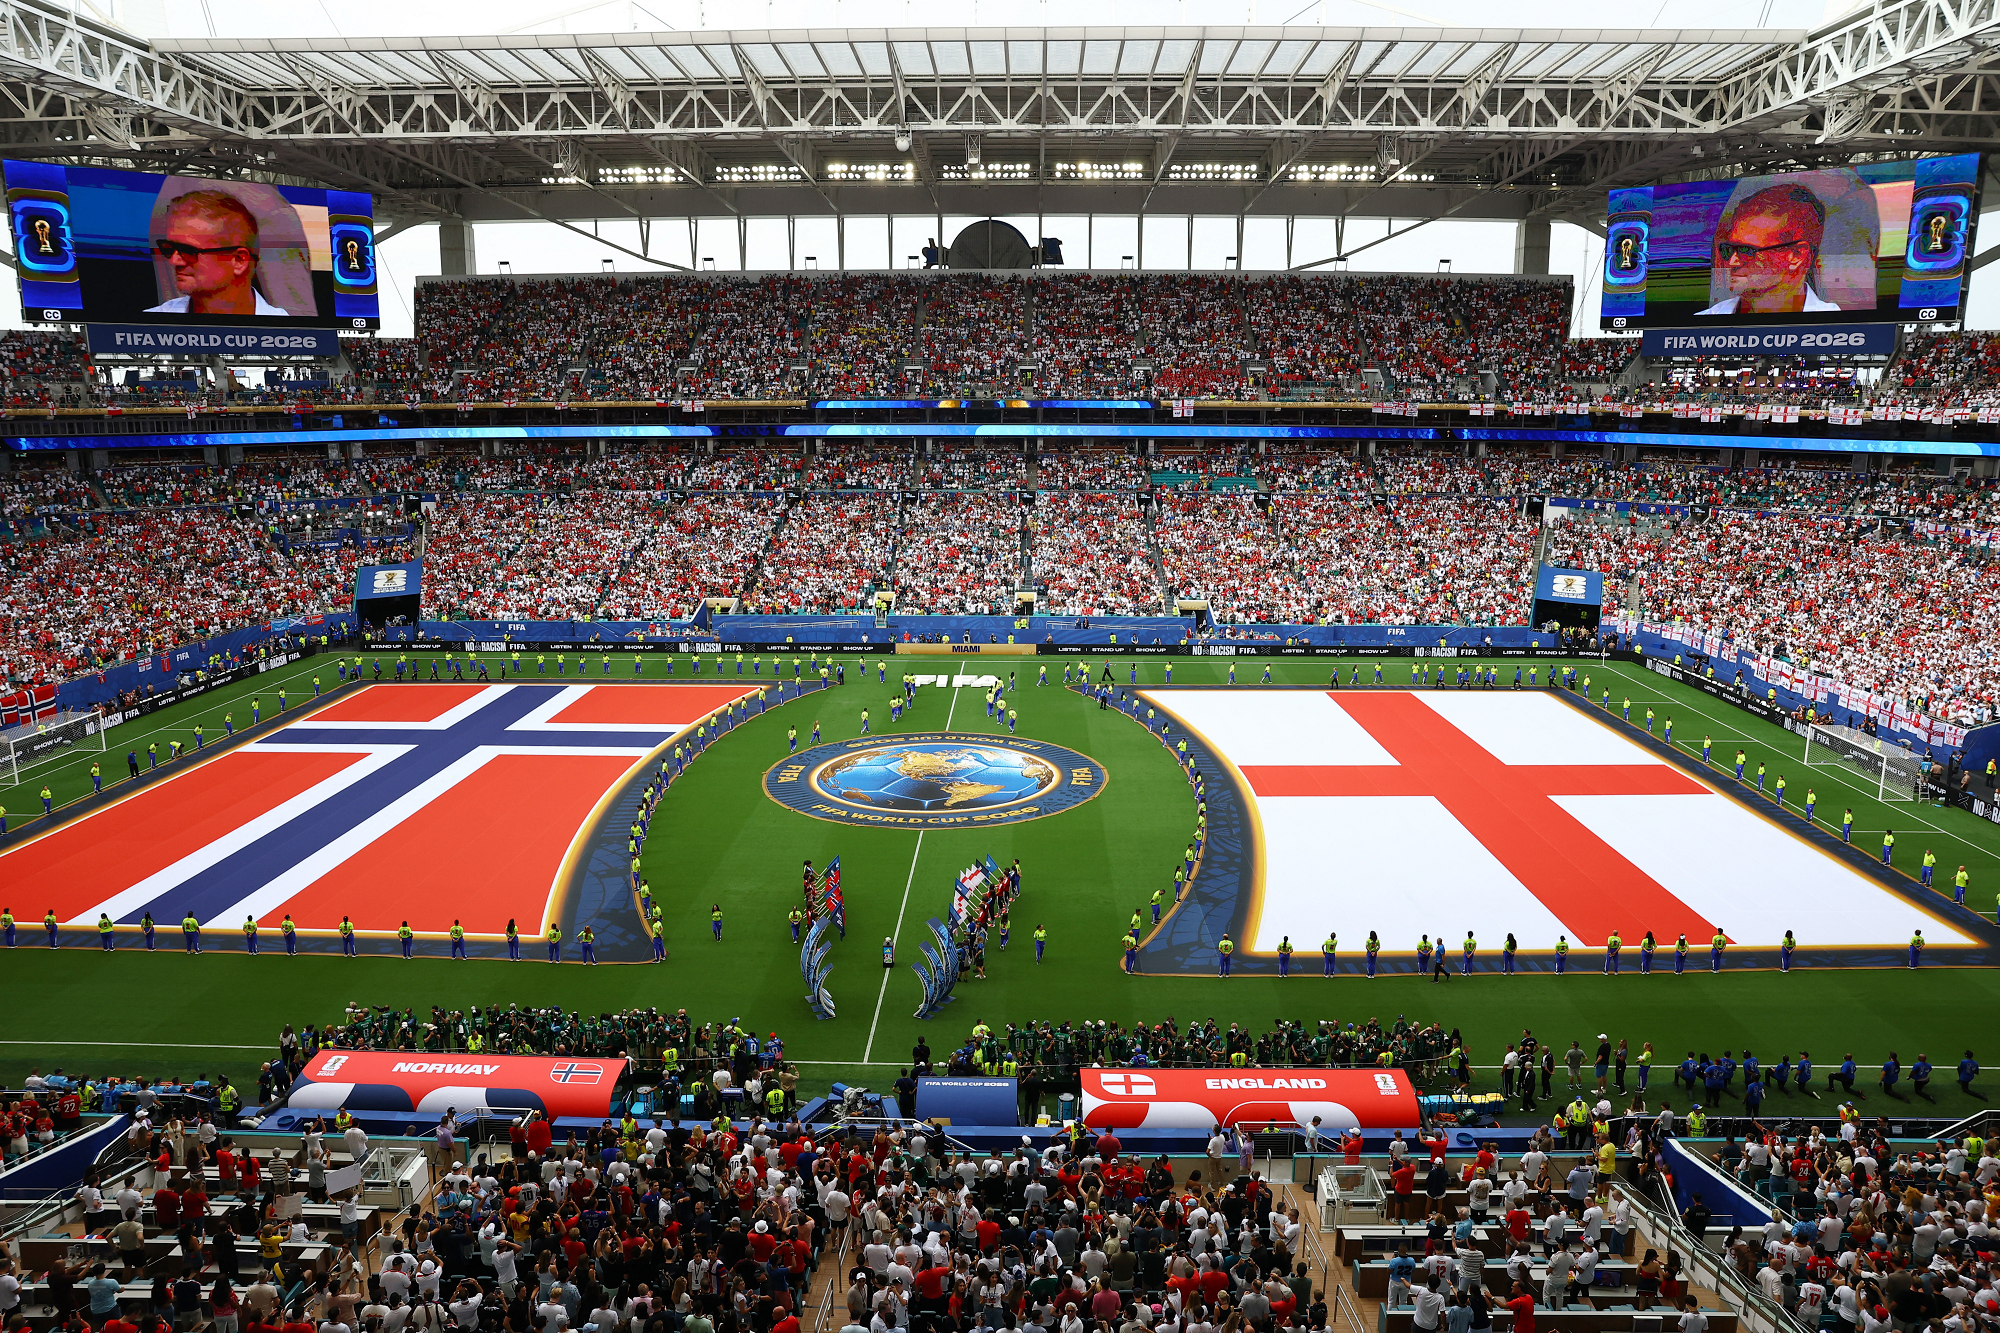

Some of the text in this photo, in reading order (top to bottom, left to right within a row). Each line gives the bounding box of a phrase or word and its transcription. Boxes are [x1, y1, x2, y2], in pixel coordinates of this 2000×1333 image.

[47, 311, 59, 319] CC
[1920, 310, 1936, 319] CC
[354, 319, 365, 327] CC
[1614, 319, 1626, 327] CC
[116, 332, 317, 348] FIFA WORLD CUP 2026
[1664, 333, 1866, 349] FIFA WORLD CUP 2026
[465, 642, 475, 652] NO
[482, 642, 506, 652] RACISM
[679, 642, 690, 652] NO
[696, 642, 722, 652] RACISM
[1192, 646, 1202, 656] NO
[1210, 646, 1236, 656] RACISM
[1414, 647, 1424, 657] NO
[1432, 647, 1458, 658] RACISM
[176, 652, 190, 662] FIFA
[258, 652, 301, 674] NO RACISM FIFA
[915, 674, 999, 687] FIFA
[1672, 670, 1683, 681] FIFA
[158, 696, 176, 706] LISTEN
[182, 688, 198, 698] STAND
[212, 678, 224, 686] SHOW
[1722, 692, 1736, 702] STAND
[1748, 704, 1761, 713] SHOW
[86, 708, 140, 736] NO RACISM FIFA
[1784, 716, 1830, 746] NO RACIM FIFA
[34, 740, 54, 750] SHOW
[945, 736, 1004, 744] WORLD
[1008, 740, 1042, 750] FIFA
[778, 764, 806, 784] FIFA
[1071, 766, 1092, 786] FIFA
[1936, 786, 1946, 795] UP
[1972, 798, 1984, 817] NO
[810, 804, 849, 818] FIFA
[850, 812, 924, 824] WORLD
[972, 806, 1041, 822] 2026
[392, 1062, 501, 1075] NORWAY
[1206, 1078, 1327, 1090] ENGLAND
[64, 1102, 76, 1112] 22
[1798, 1167, 1808, 1176] 24
[522, 1190, 533, 1202] 10
[453, 1219, 464, 1231] 26
[585, 1218, 599, 1228] 26
[1396, 1266, 1412, 1276] 22
[1436, 1266, 1446, 1278] 12
[1816, 1266, 1828, 1278] 15
[1809, 1292, 1820, 1306] 17
